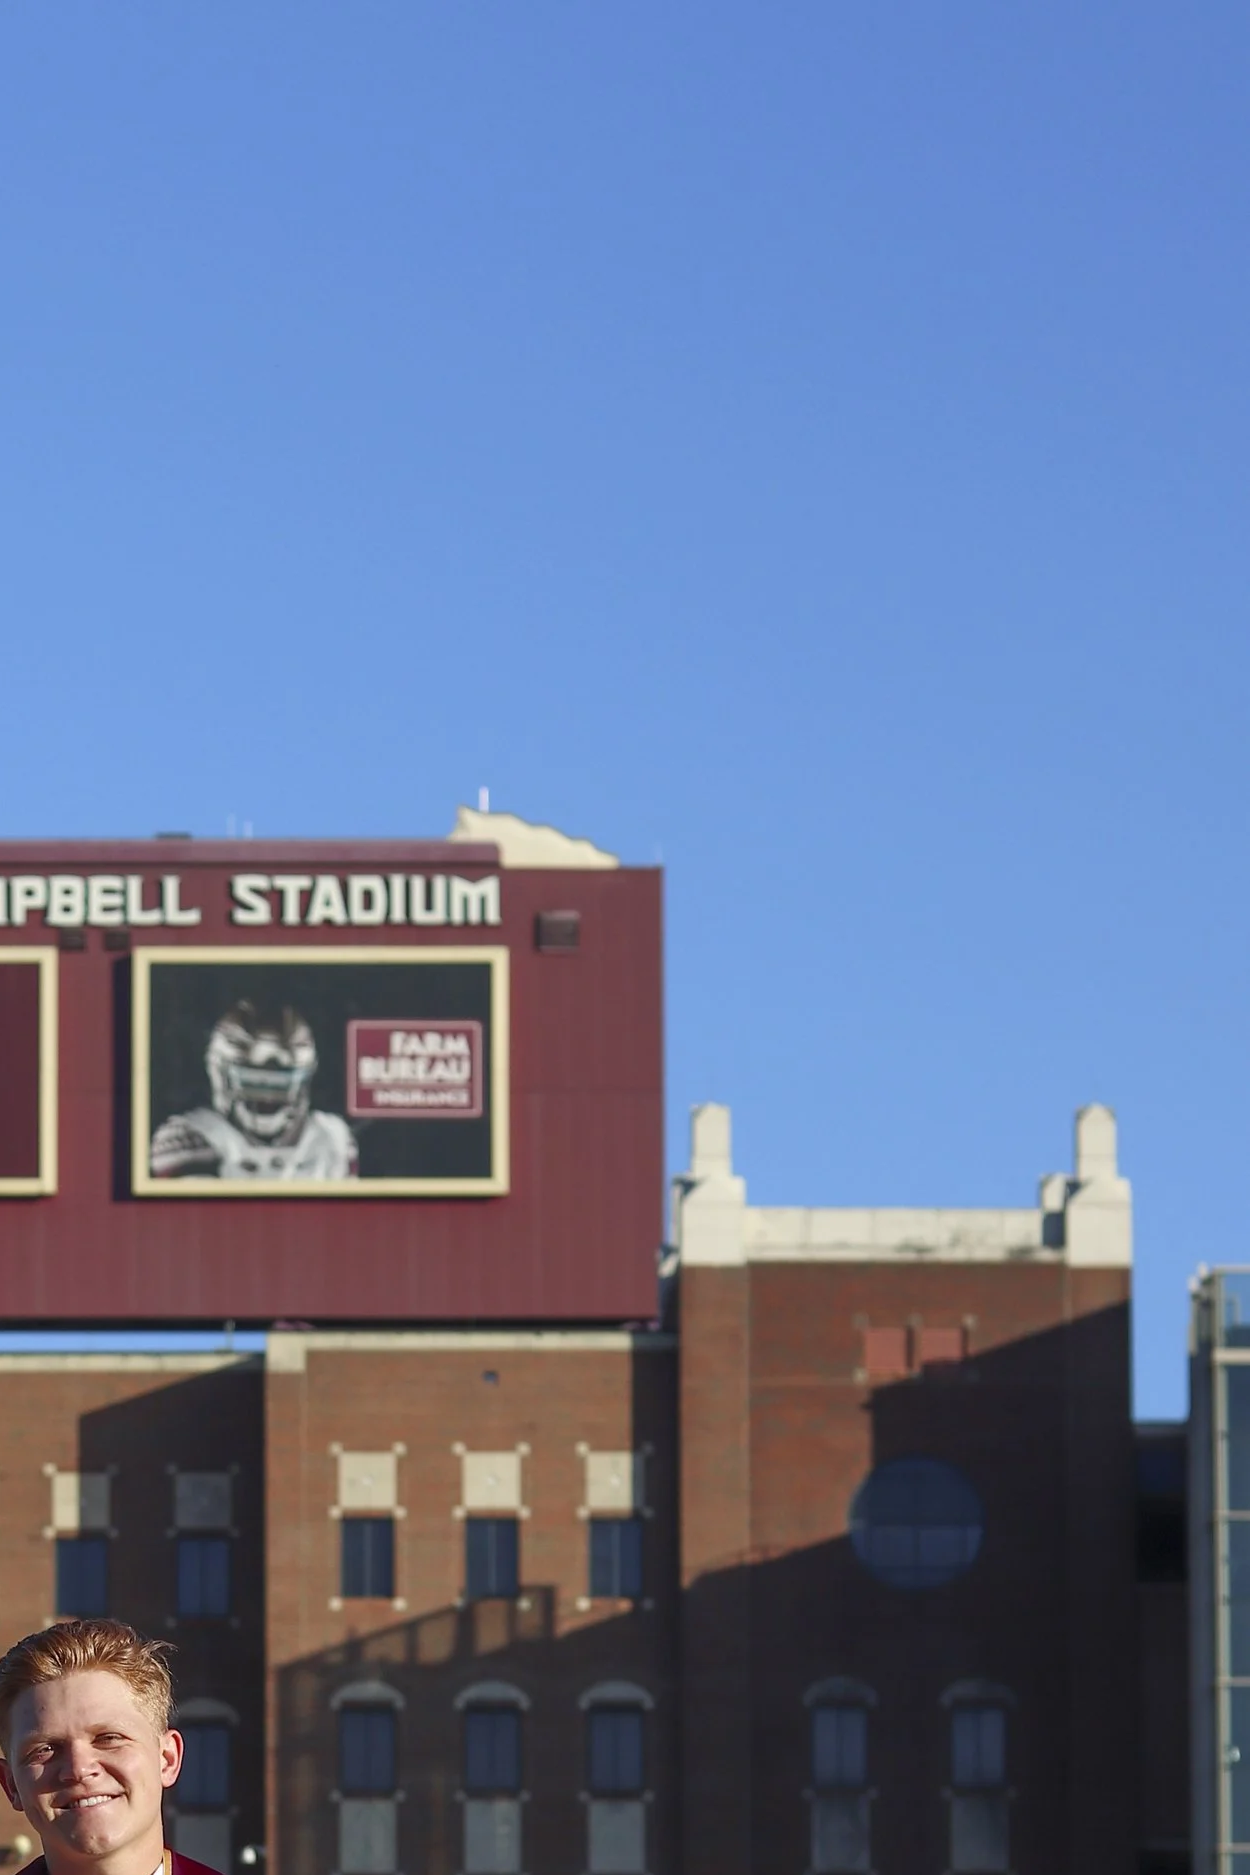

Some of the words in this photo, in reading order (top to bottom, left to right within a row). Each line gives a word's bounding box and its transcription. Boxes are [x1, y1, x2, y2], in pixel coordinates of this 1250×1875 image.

[231, 873, 502, 927] STADIUM
[390, 1030, 470, 1055] FARM
[358, 1056, 471, 1083] BUREAU
